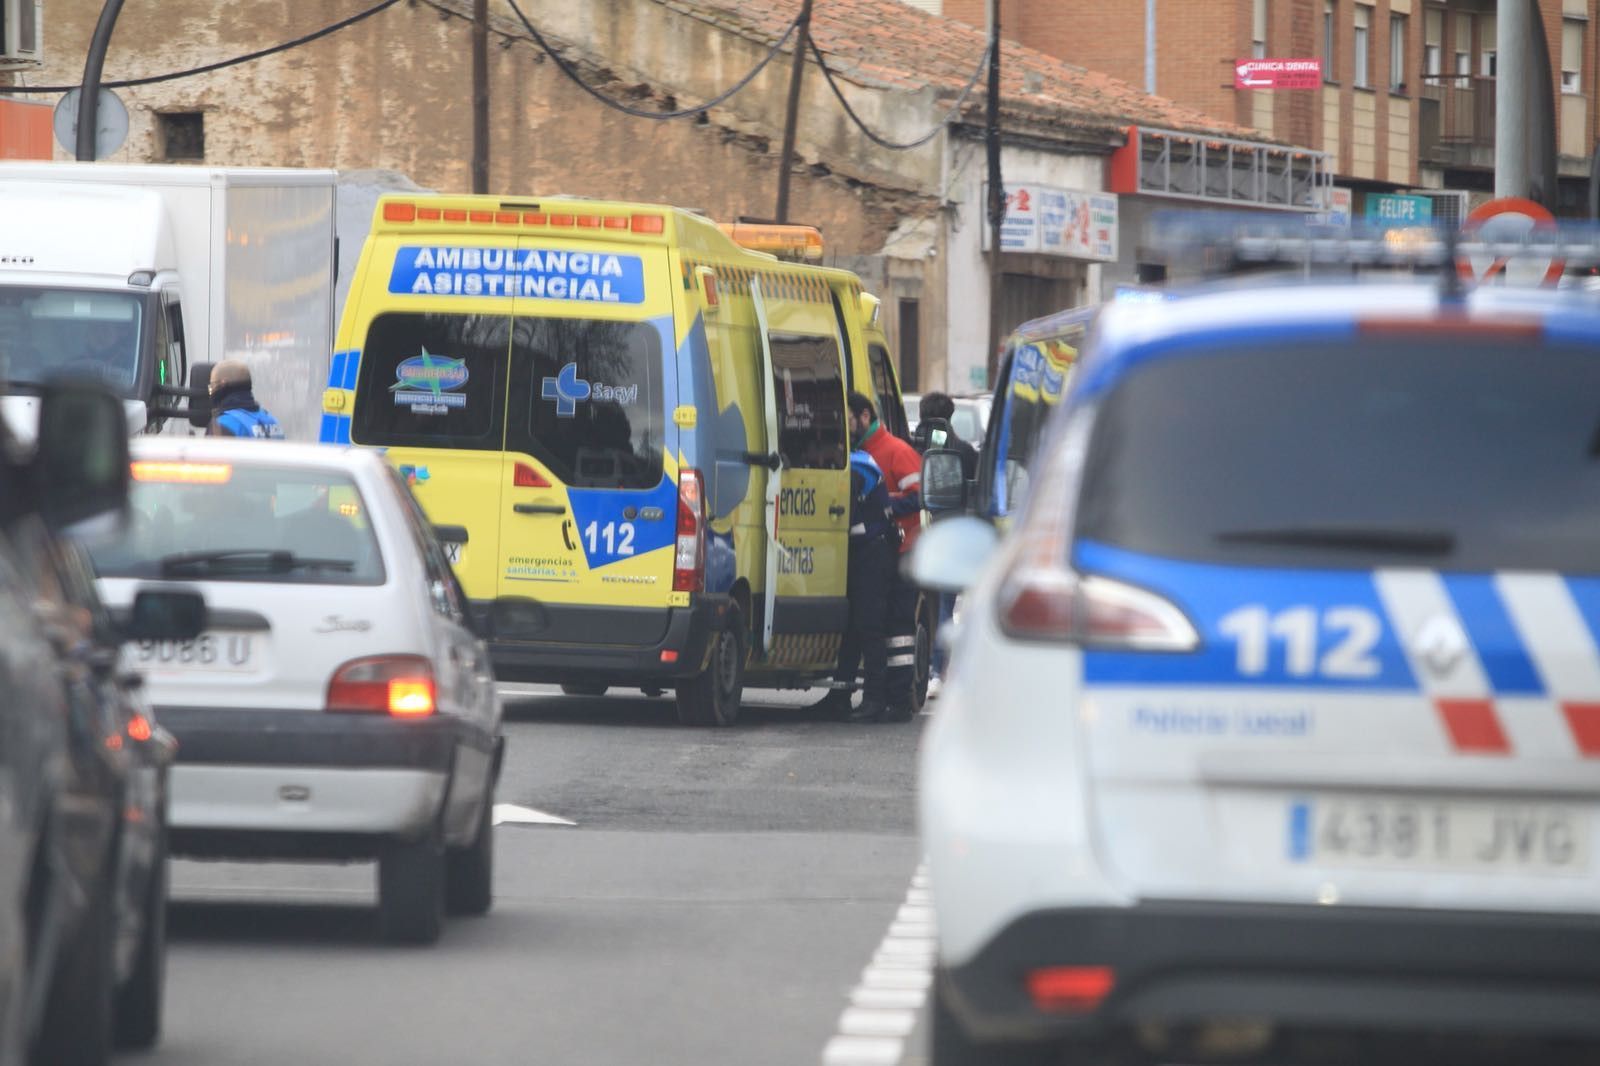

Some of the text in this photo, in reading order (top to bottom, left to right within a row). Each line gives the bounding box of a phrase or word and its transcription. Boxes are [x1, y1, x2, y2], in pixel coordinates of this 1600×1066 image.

[1286, 62, 1320, 72] DENTAL
[1379, 198, 1416, 220] FELIPE
[414, 247, 623, 277] AMBULANCIA
[411, 272, 620, 301] ASISTENCIAL
[591, 382, 638, 404] Sacyl
[585, 520, 635, 555] 112
[508, 555, 573, 567] emergencias
[601, 574, 658, 584] RENAULT
[1218, 604, 1383, 680] 112
[1321, 800, 1578, 866] 4381 JVG
